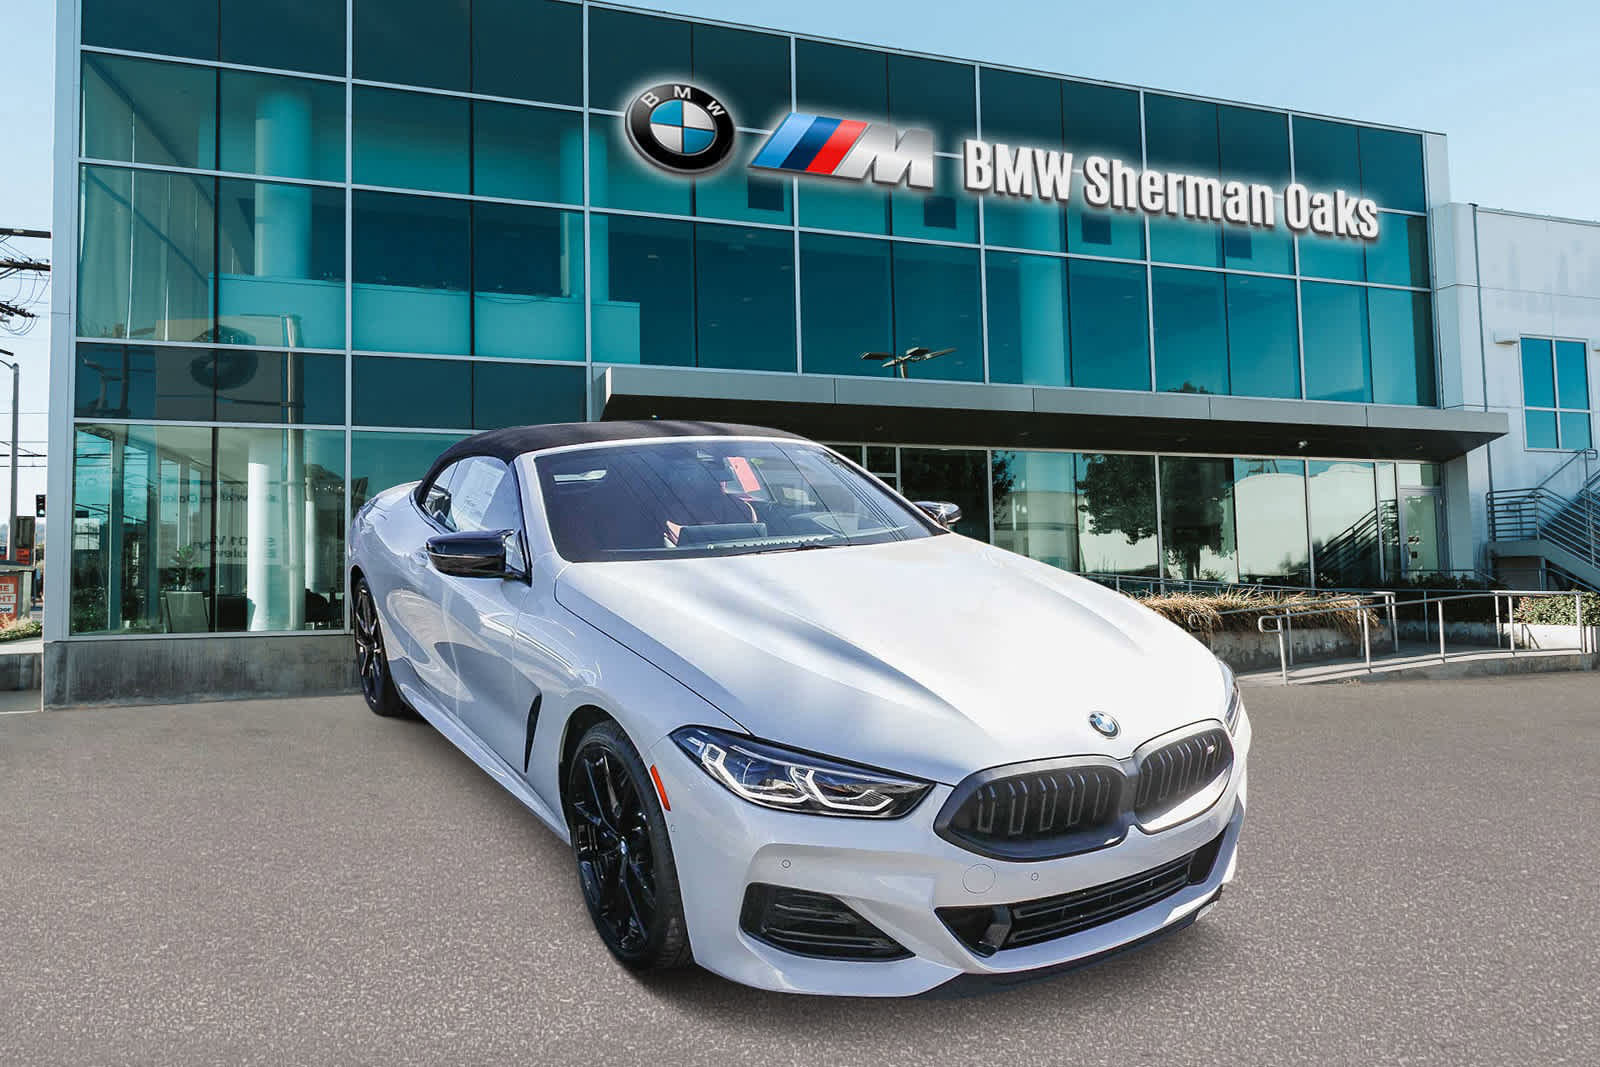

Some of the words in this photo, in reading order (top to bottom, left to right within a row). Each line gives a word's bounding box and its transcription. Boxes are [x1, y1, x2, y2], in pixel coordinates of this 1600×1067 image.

[641, 85, 726, 117] BMW
[831, 123, 935, 191] M
[963, 138, 1073, 202] BMW
[1083, 155, 1275, 228] Sherman
[1284, 182, 1380, 241] Oaks
